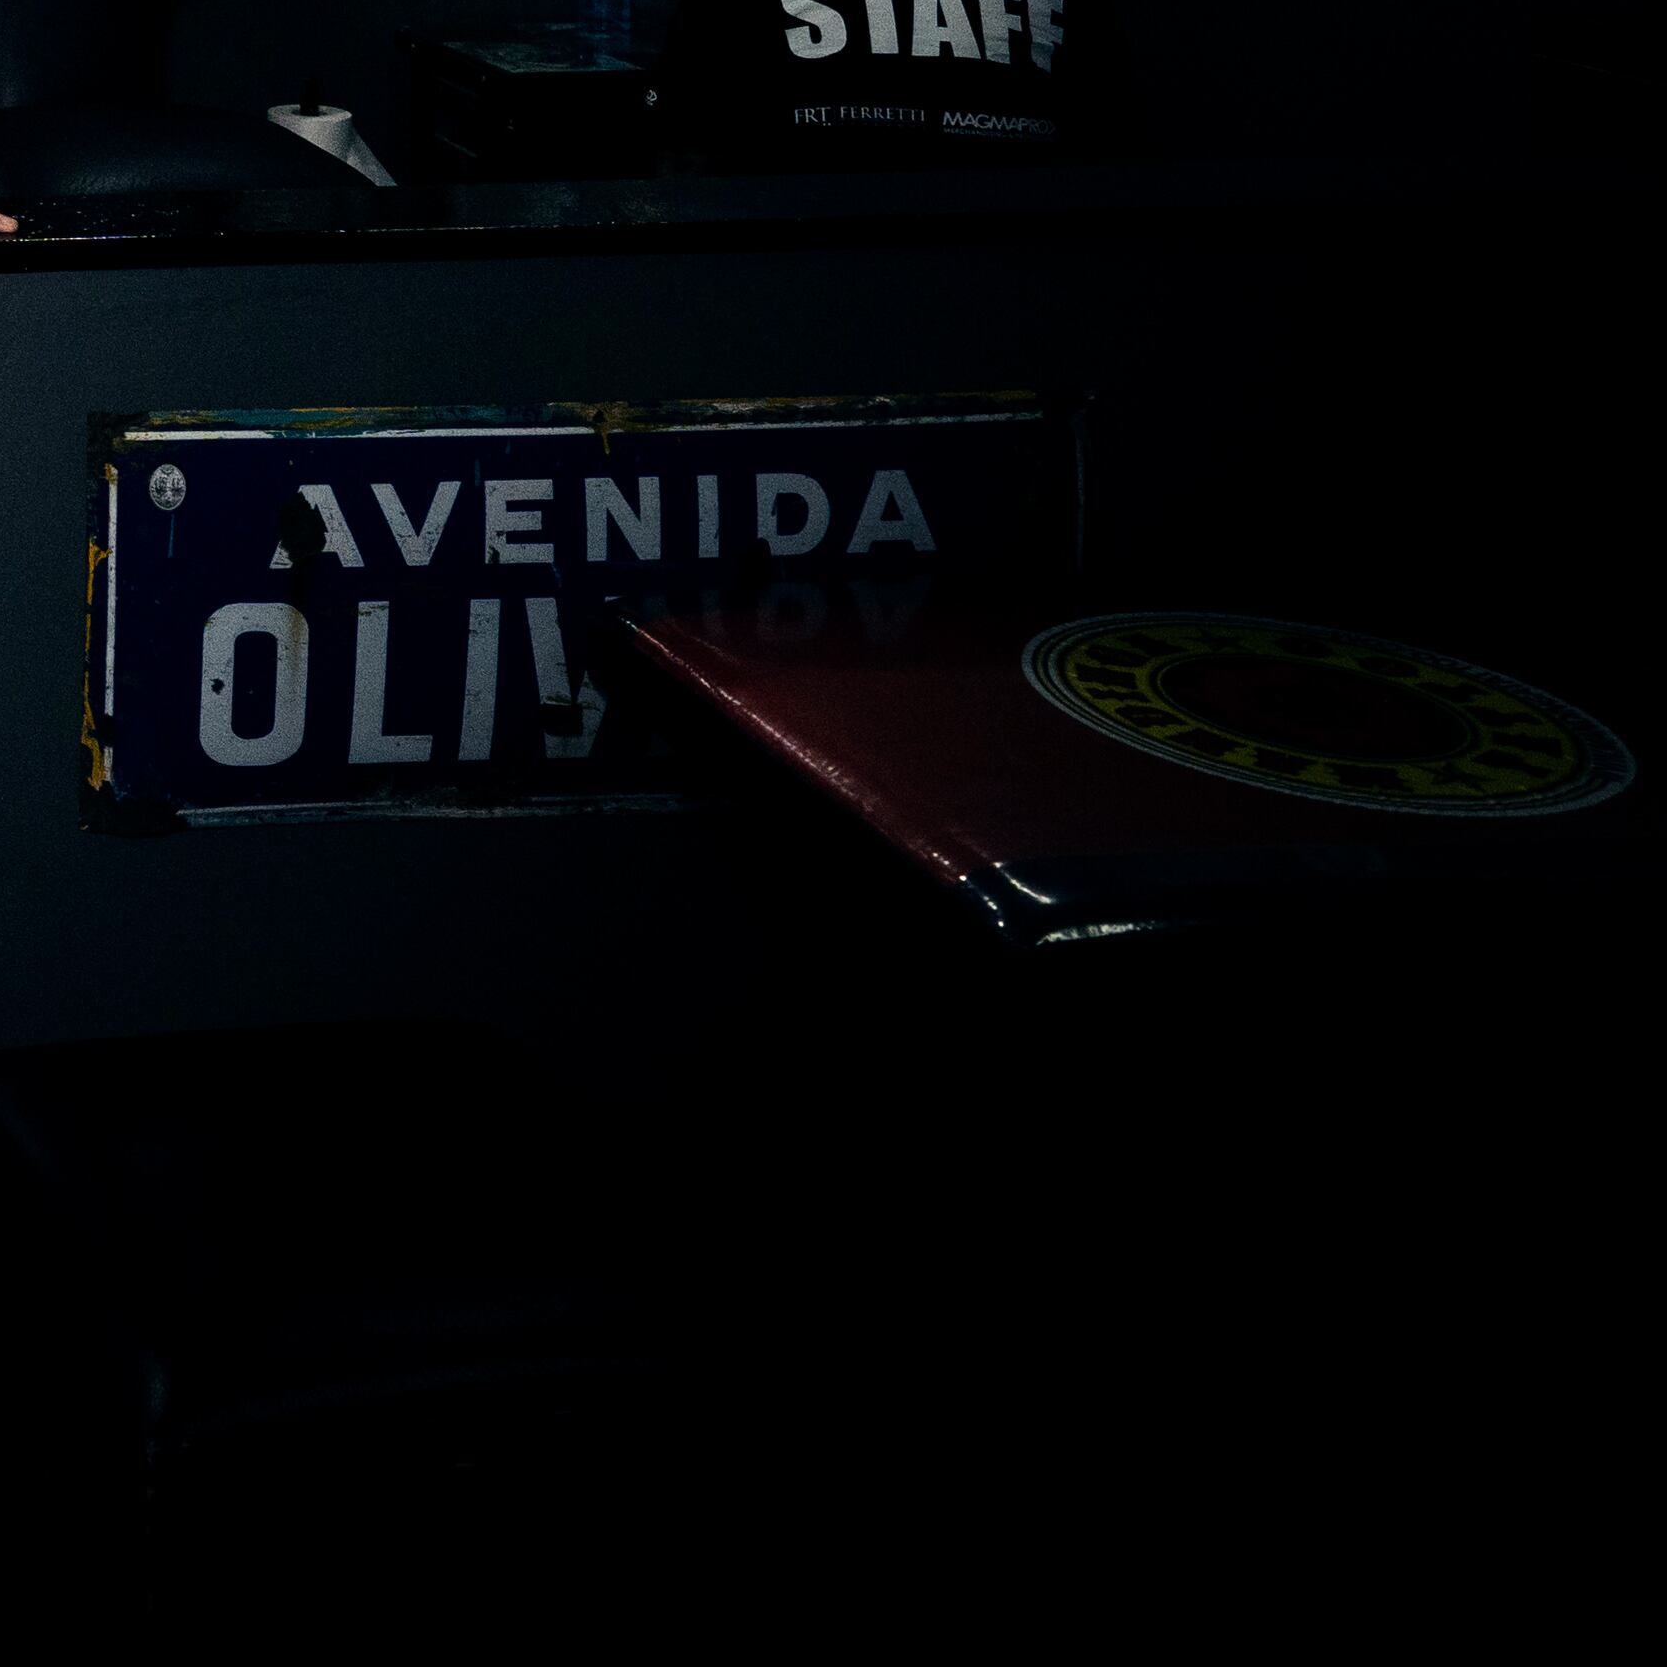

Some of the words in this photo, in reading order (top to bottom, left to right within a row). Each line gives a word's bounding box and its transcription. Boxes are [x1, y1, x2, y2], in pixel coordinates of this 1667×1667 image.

[793, 106, 832, 127] FRT
[839, 105, 927, 123] FERRETTI
[268, 468, 938, 570] AVENIDA
[198, 595, 625, 767] OLIV
